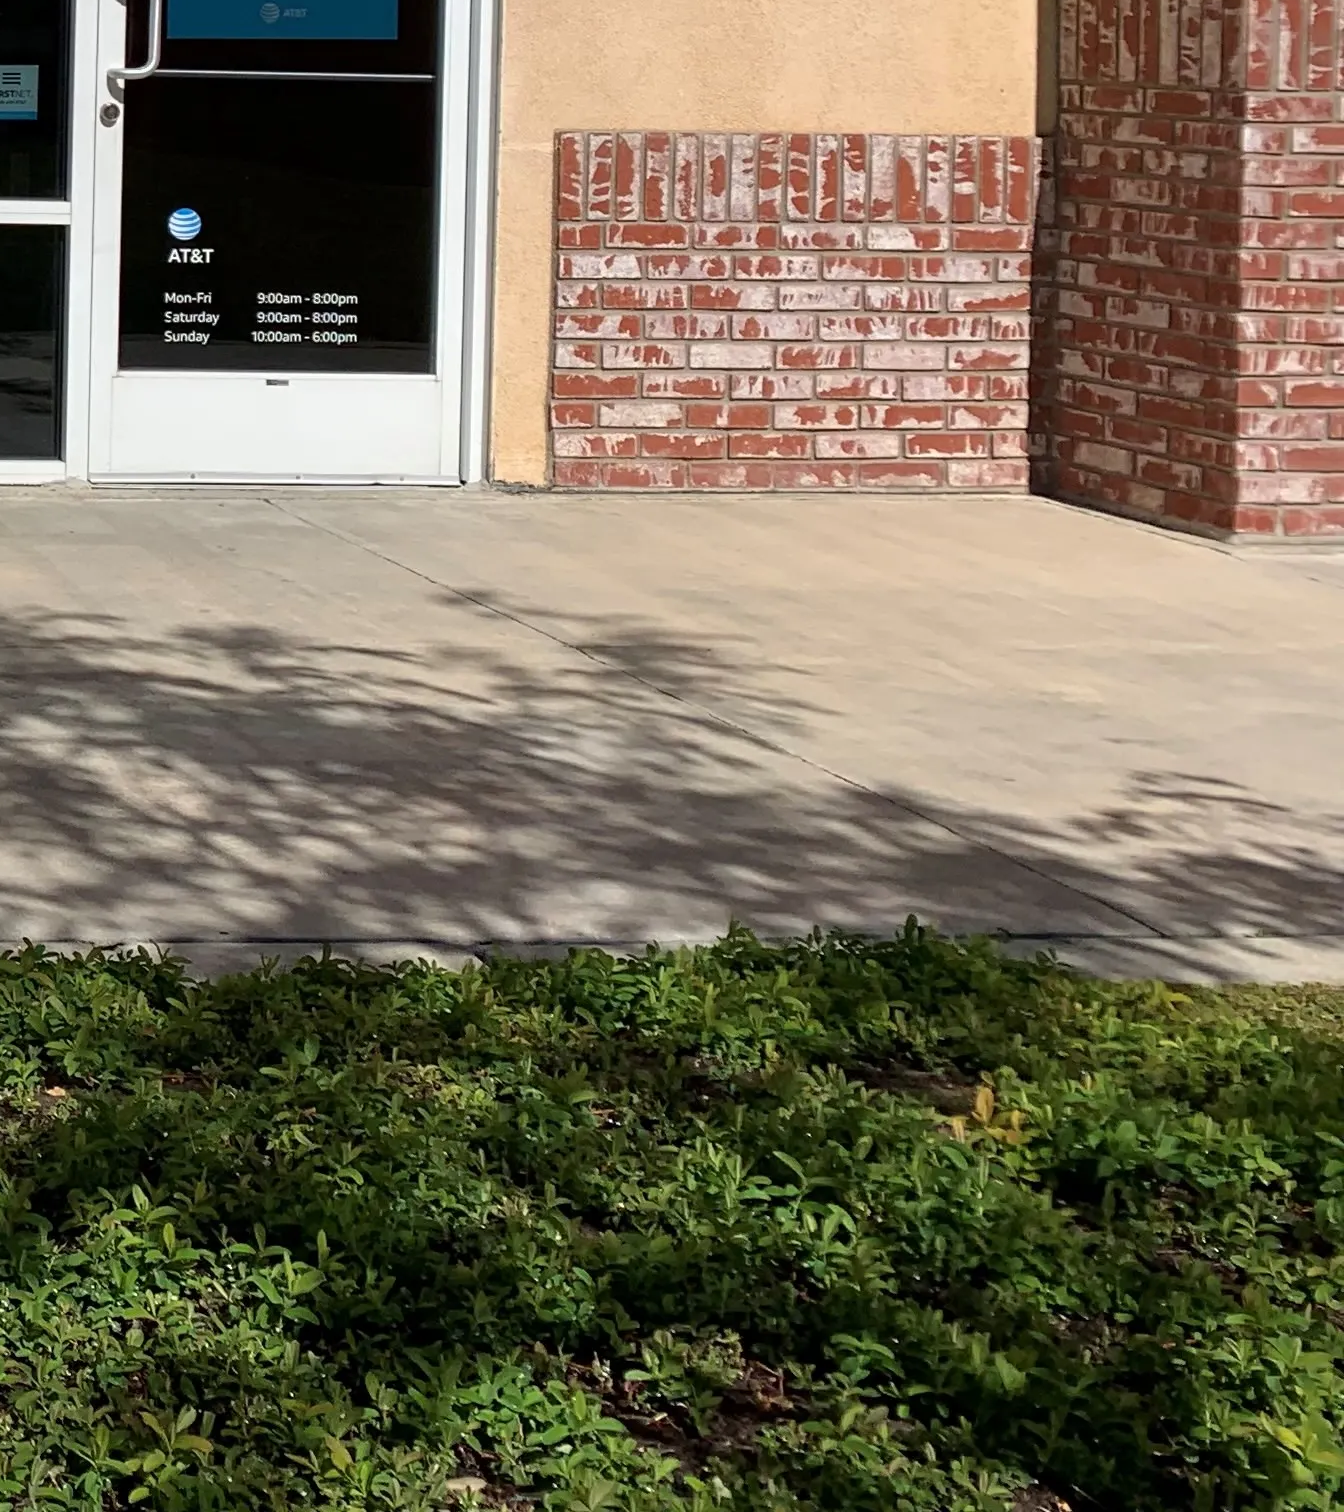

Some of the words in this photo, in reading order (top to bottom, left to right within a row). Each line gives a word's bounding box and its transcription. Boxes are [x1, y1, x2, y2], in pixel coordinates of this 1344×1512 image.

[168, 248, 214, 264] AT&T
[164, 291, 212, 305] Mon-Fri
[256, 292, 302, 305] 9:00am
[312, 292, 358, 307] 8:00pm
[164, 311, 220, 326] Saturday
[256, 311, 302, 324] 9:00am
[312, 311, 358, 326] 8:00pm
[164, 330, 210, 345] Sunday
[251, 330, 302, 343] 10:00am
[312, 331, 358, 345] 6:00pm
